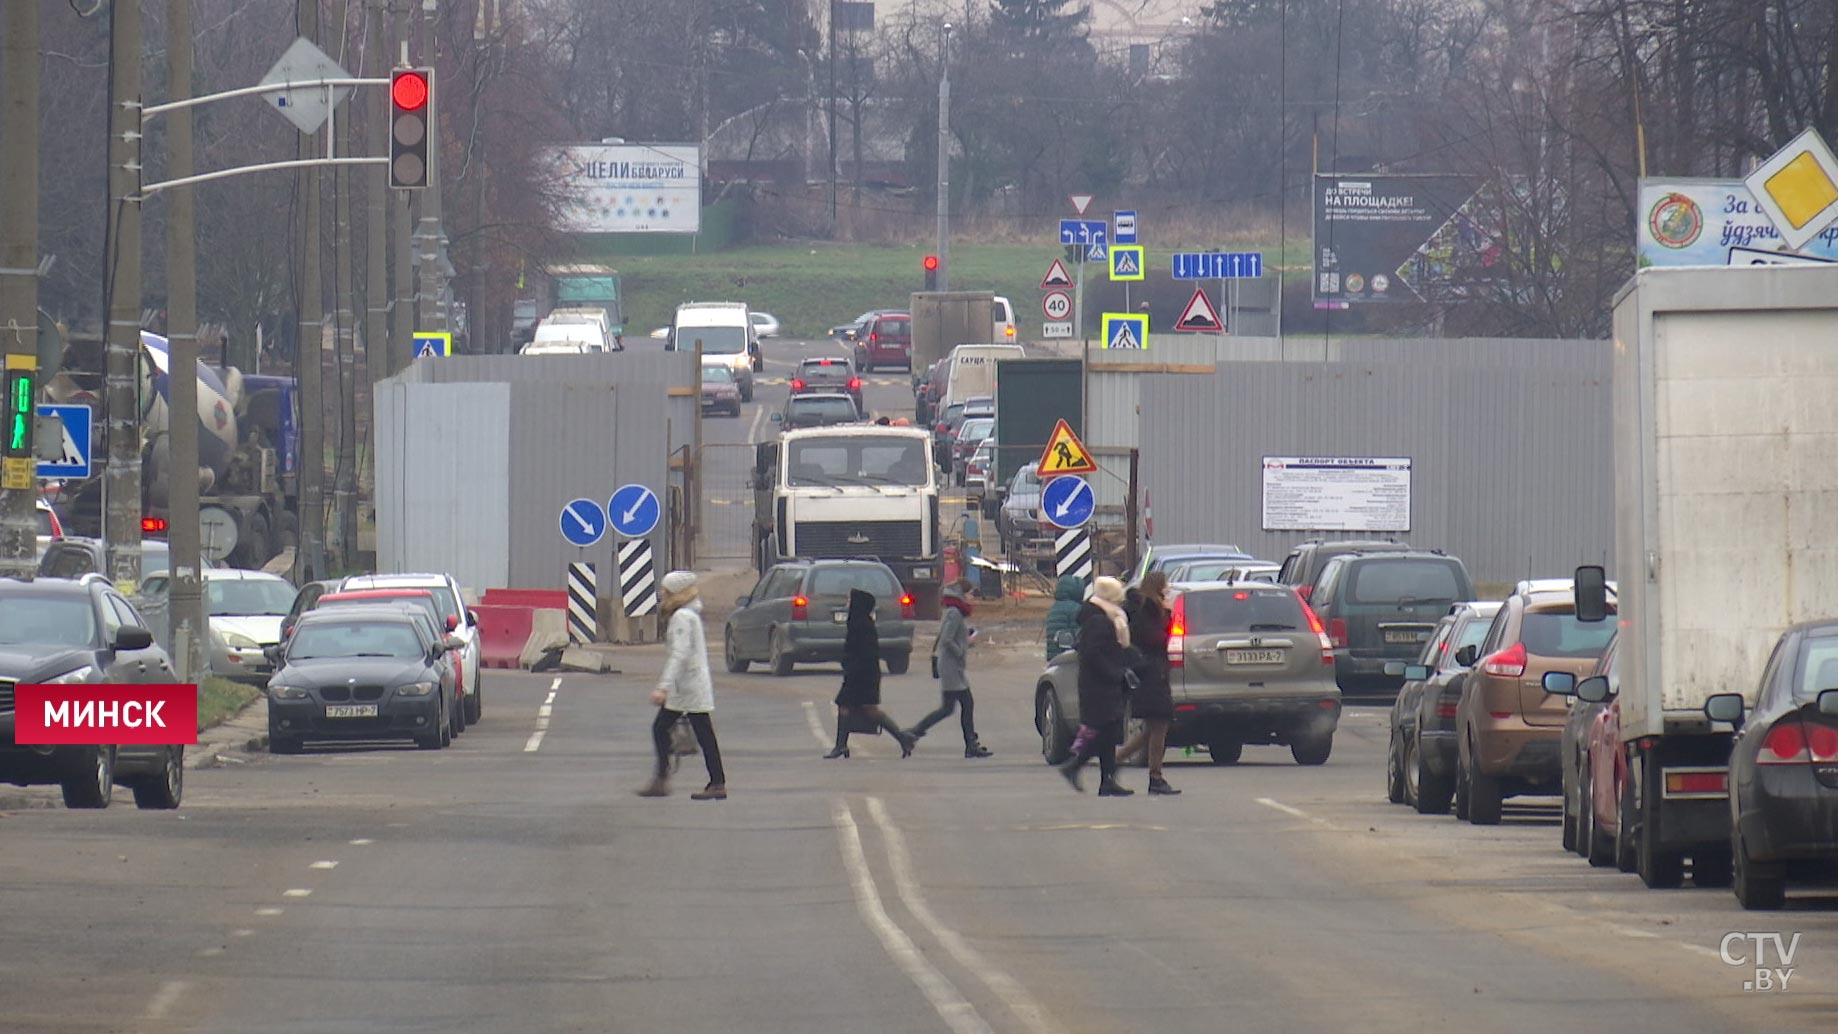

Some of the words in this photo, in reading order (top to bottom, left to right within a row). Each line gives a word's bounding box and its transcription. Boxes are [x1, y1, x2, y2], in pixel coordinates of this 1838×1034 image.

[587, 162, 630, 179] ЦЕЛИ
[1325, 196, 1341, 206] НА
[1343, 196, 1414, 208] ПЛОЩАДКЕ!
[1724, 194, 1748, 214] За
[1048, 299, 1066, 311] 40
